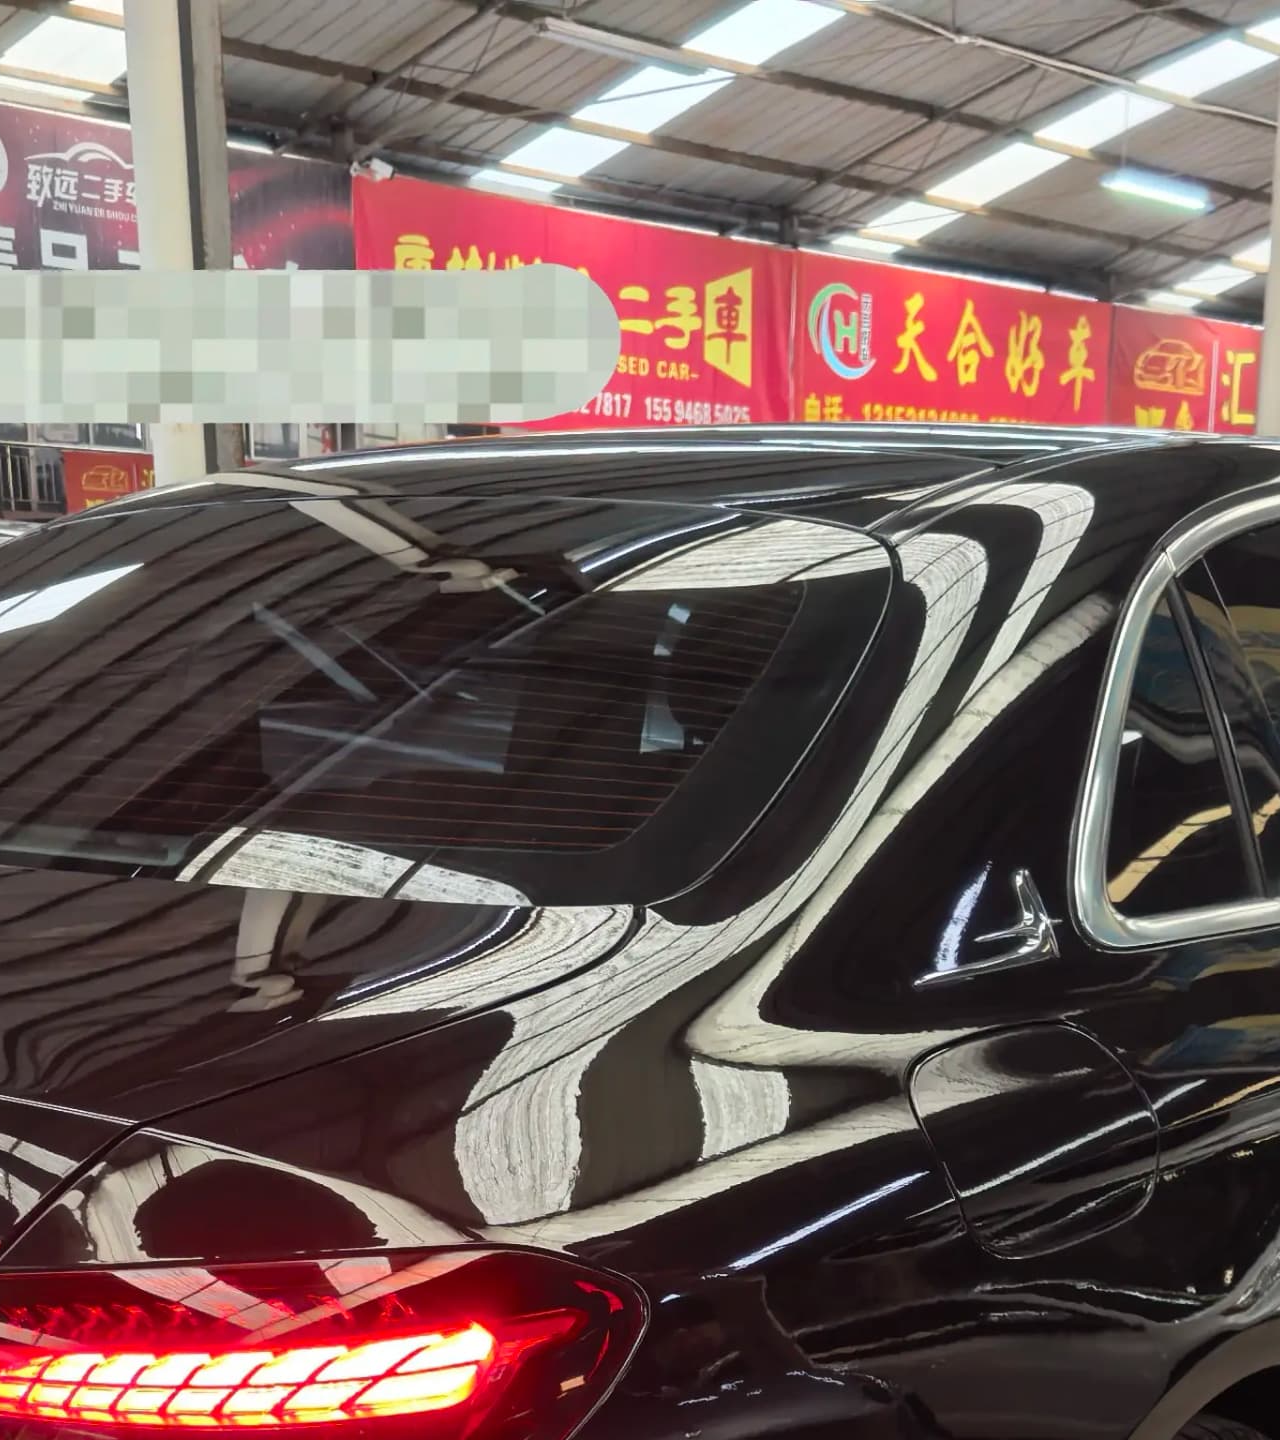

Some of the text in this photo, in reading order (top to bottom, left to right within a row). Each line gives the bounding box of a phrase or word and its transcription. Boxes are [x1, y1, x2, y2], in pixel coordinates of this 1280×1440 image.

[616, 354, 650, 376] SED
[892, 291, 1095, 412] 天合好车
